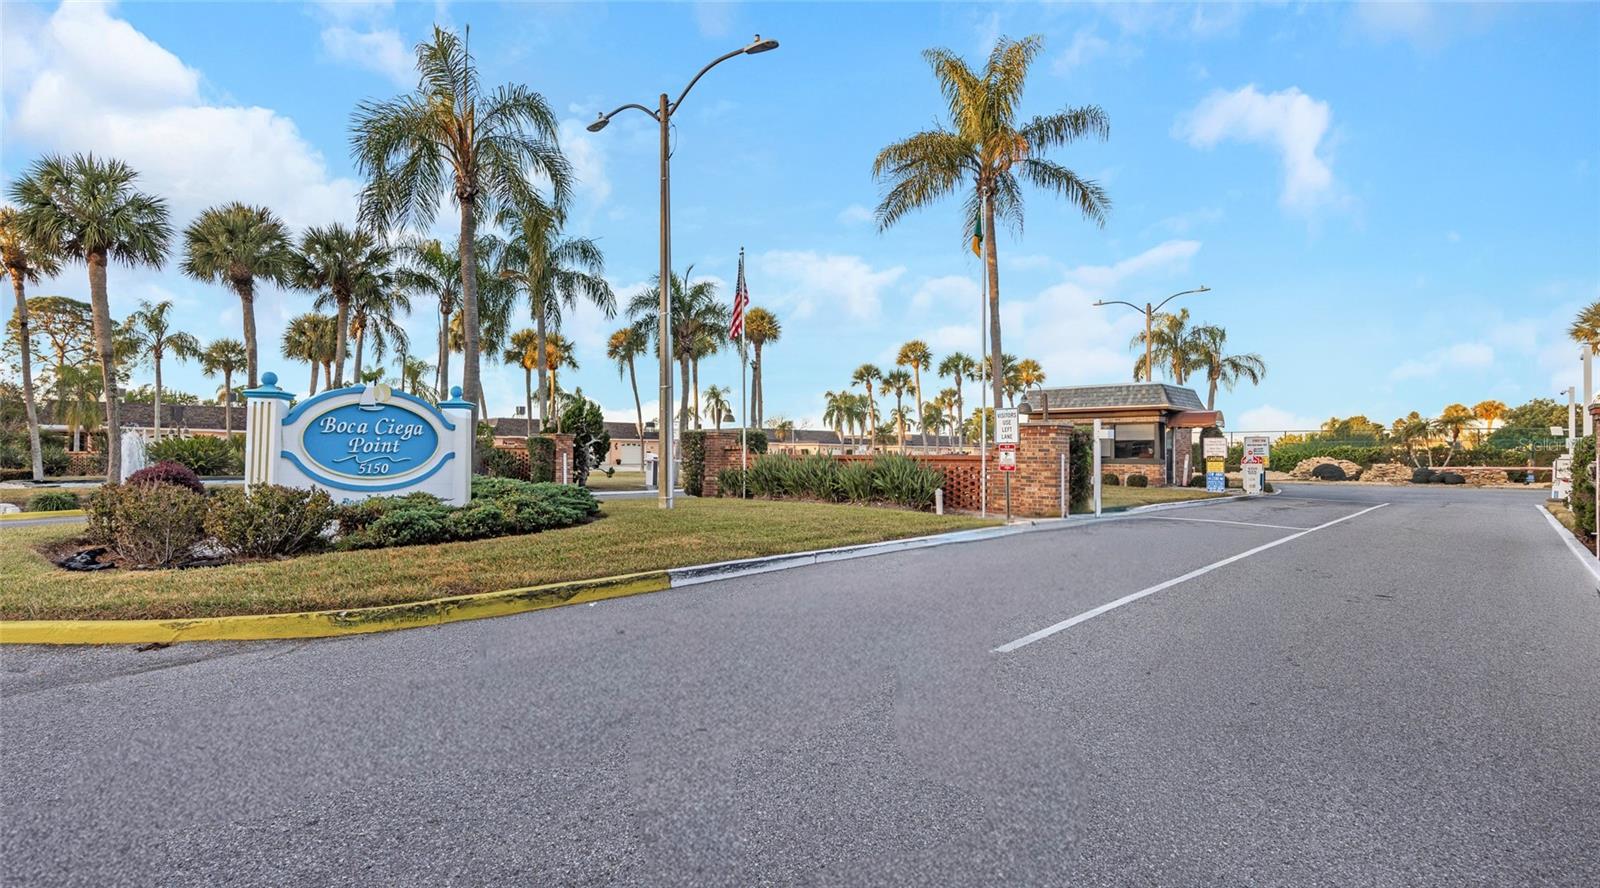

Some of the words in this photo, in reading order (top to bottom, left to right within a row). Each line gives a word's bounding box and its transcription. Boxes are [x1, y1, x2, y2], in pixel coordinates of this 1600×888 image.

[320, 417, 368, 433] Boca
[375, 417, 423, 440] Ciega
[348, 438, 400, 453] Point
[358, 463, 389, 474] 5150
